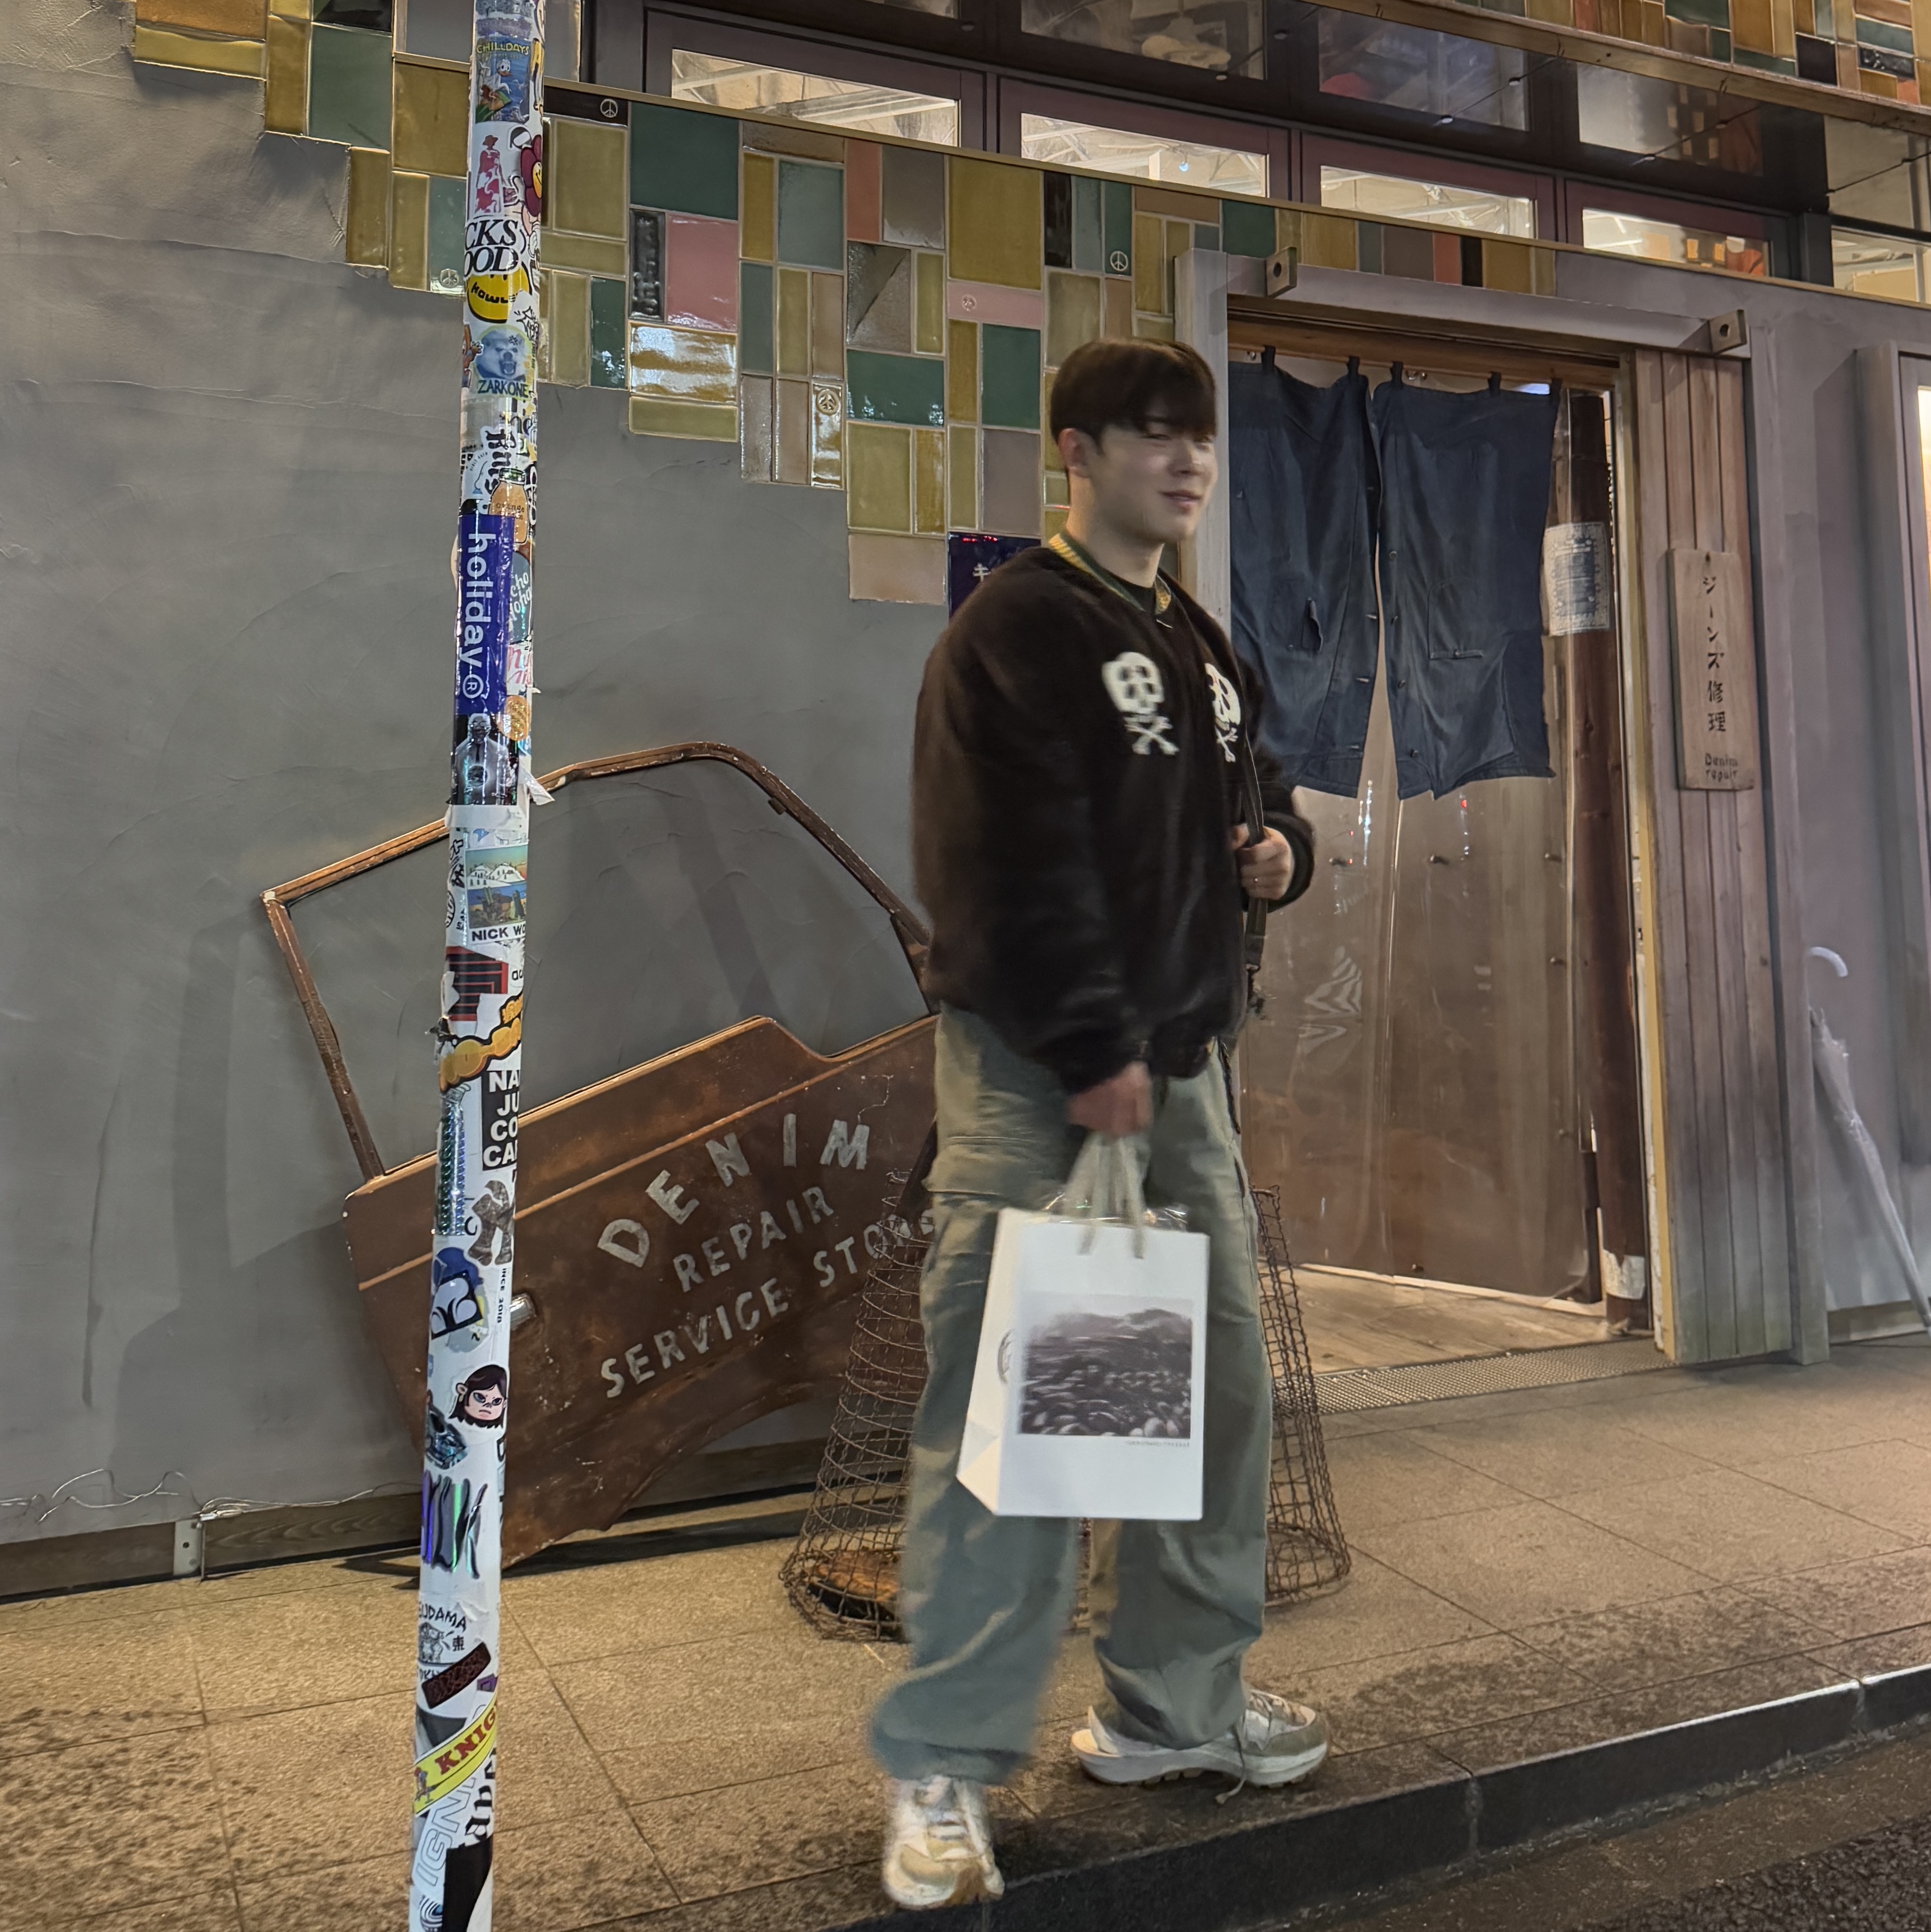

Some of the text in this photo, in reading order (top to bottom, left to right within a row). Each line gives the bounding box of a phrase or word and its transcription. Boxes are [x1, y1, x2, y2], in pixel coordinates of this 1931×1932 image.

[476, 42, 530, 56] CHILLDAYS
[478, 379, 529, 398] ZARKONE
[459, 533, 496, 668] holiday
[1702, 576, 1726, 732] ジーンズ修理
[1705, 752, 1738, 767] Denim
[1705, 769, 1738, 782] repair
[472, 927, 508, 941] NICK
[483, 1139, 517, 1167] CA
[597, 1113, 870, 1268] DENIM
[673, 1186, 834, 1292] REPAIR
[600, 1278, 789, 1398] SERVICE
[415, 1777, 477, 1887] IGN
